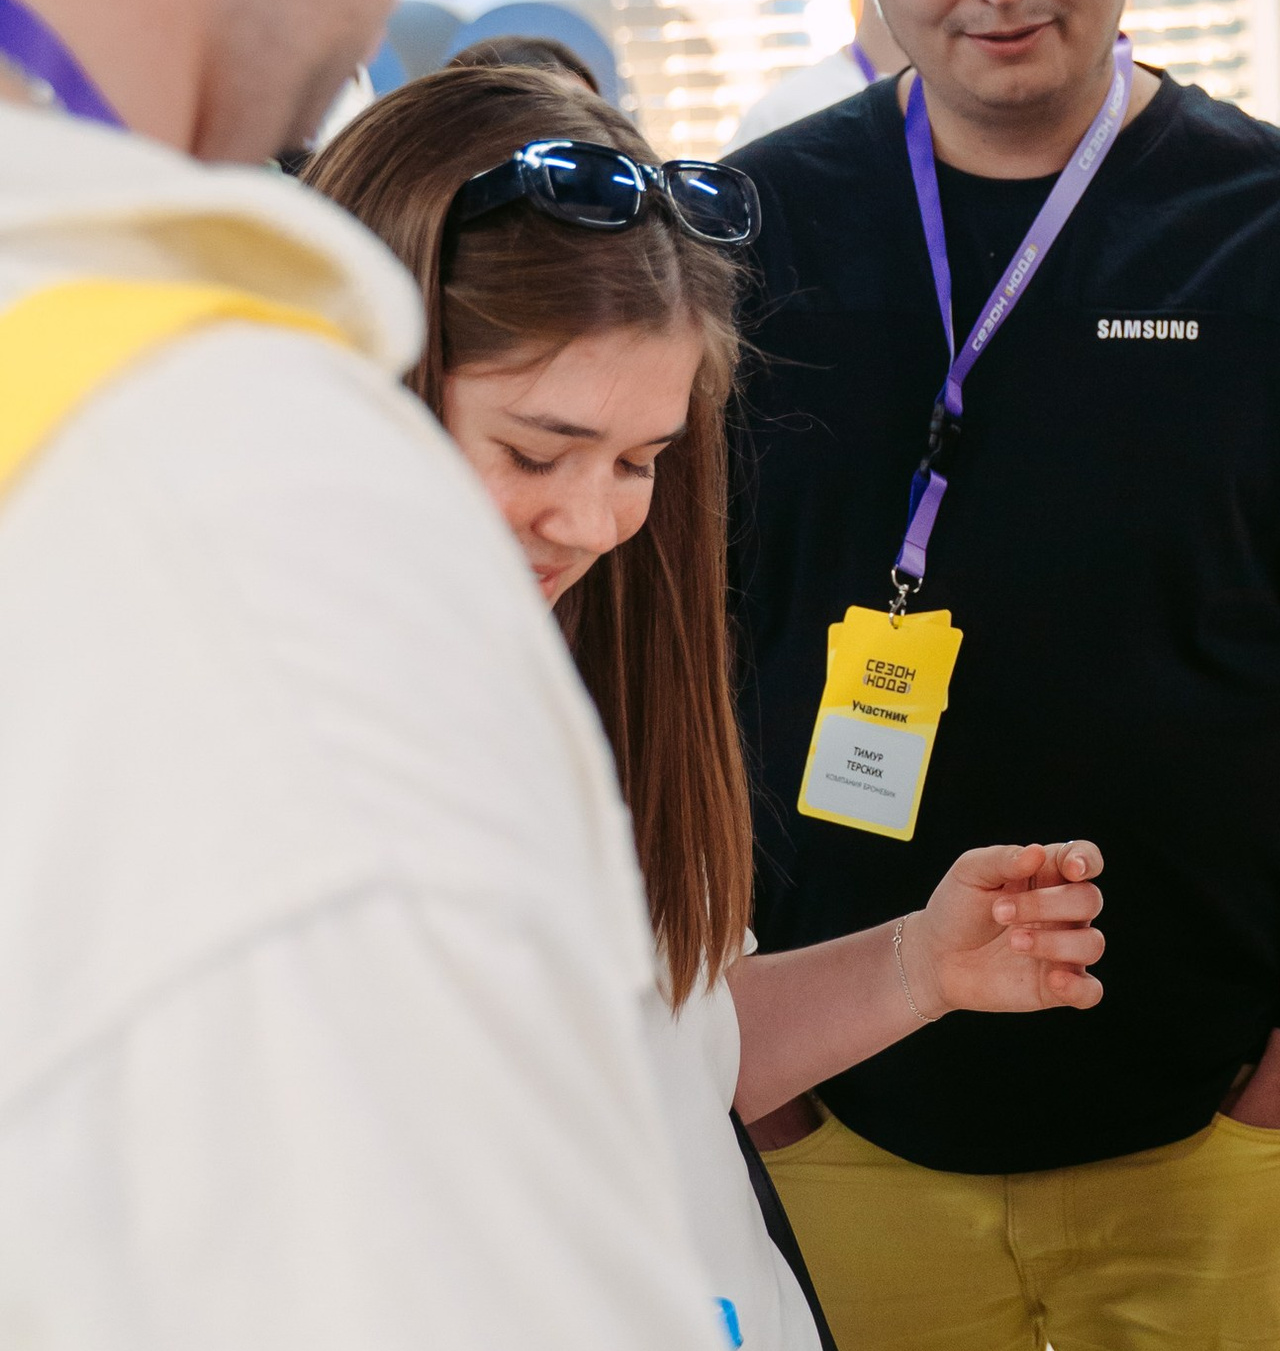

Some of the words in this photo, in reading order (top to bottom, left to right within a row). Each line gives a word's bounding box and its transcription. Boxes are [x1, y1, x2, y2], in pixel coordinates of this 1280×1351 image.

[1097, 319, 1199, 340] SAMSUNG
[852, 699, 908, 723] Участник
[854, 747, 884, 762] ТИМУР
[847, 760, 884, 778] ТЕРСКИХ
